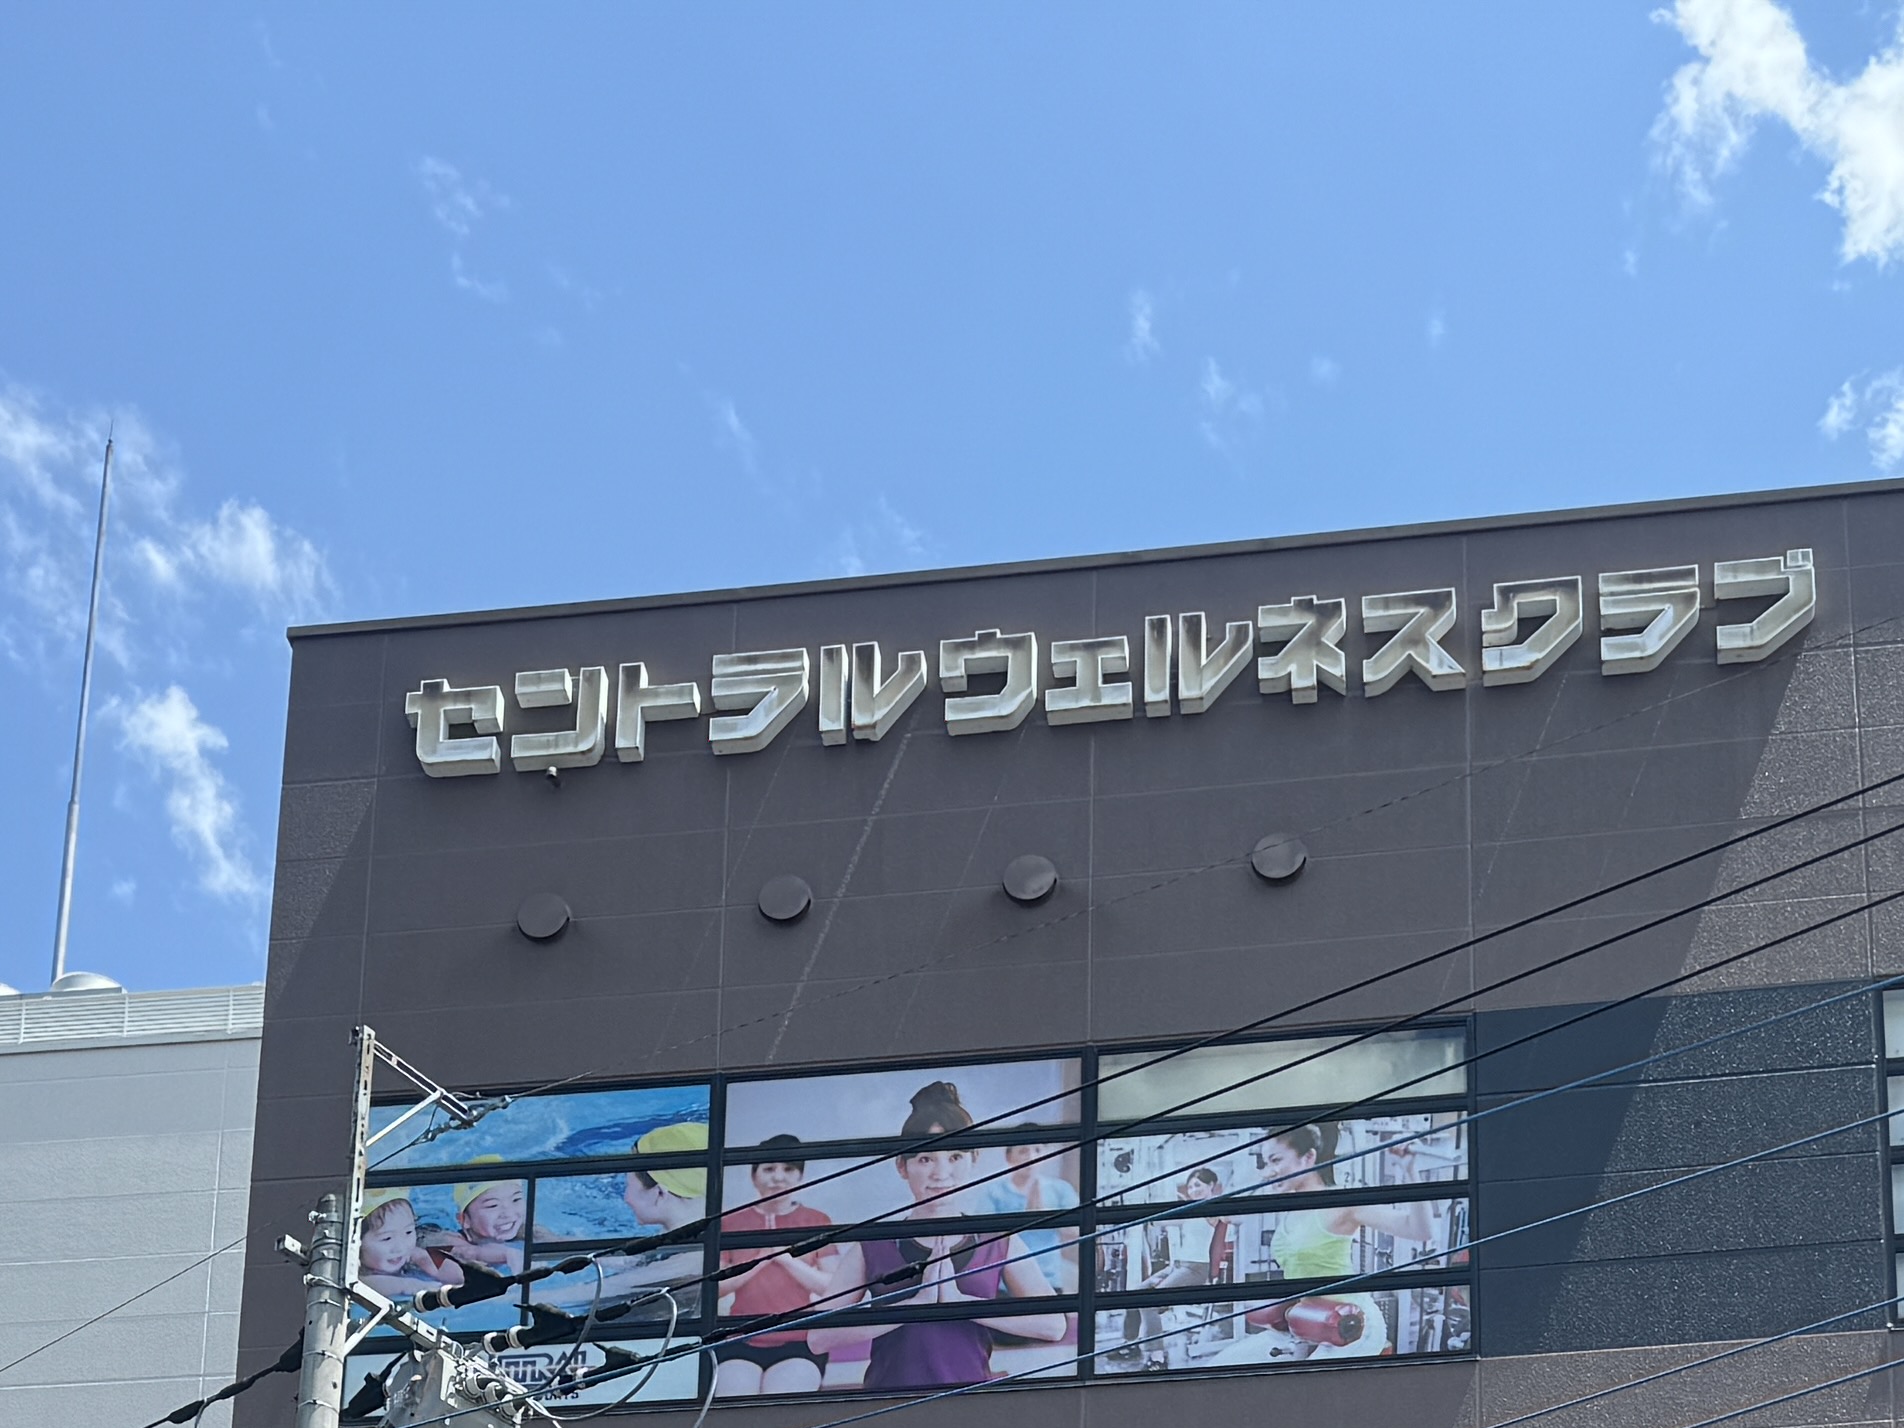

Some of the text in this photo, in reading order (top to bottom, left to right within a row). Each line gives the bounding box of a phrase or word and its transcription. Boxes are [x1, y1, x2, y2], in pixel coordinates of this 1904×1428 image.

[406, 548, 1816, 778] セントラルウェルネスクラブ
